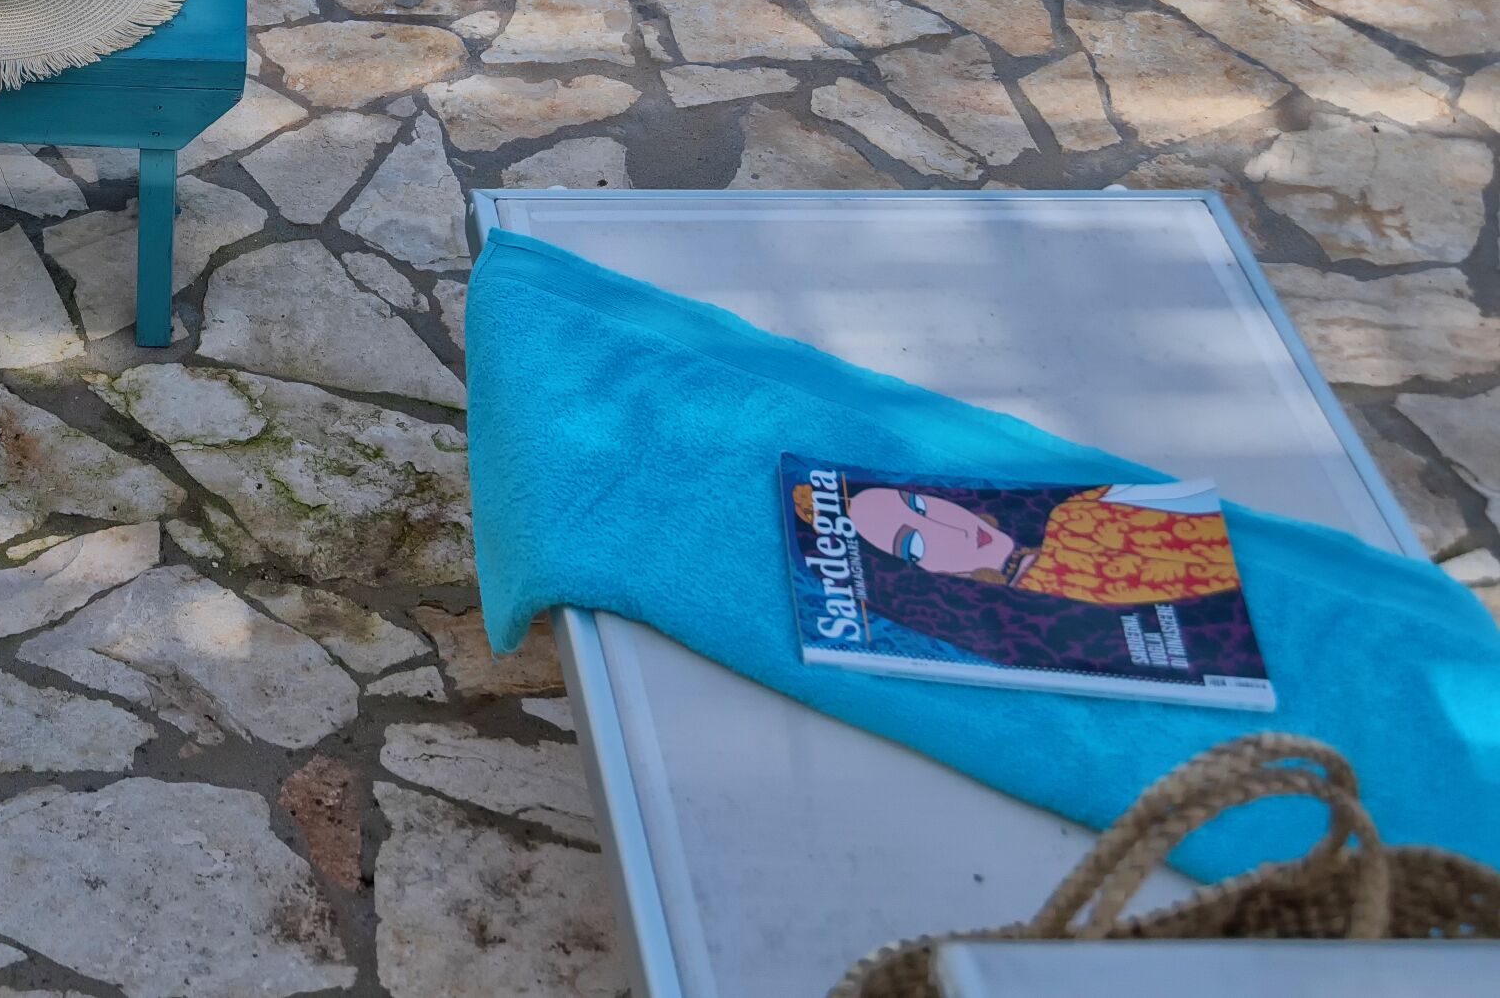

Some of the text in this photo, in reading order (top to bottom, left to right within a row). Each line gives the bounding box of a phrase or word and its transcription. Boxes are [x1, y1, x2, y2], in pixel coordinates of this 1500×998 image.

[805, 469, 861, 642] Sardegna
[847, 539, 868, 600] IMMAGINARE
[1143, 632, 1169, 666] VOGLIA
[1154, 603, 1189, 669] DI RINASCERE
